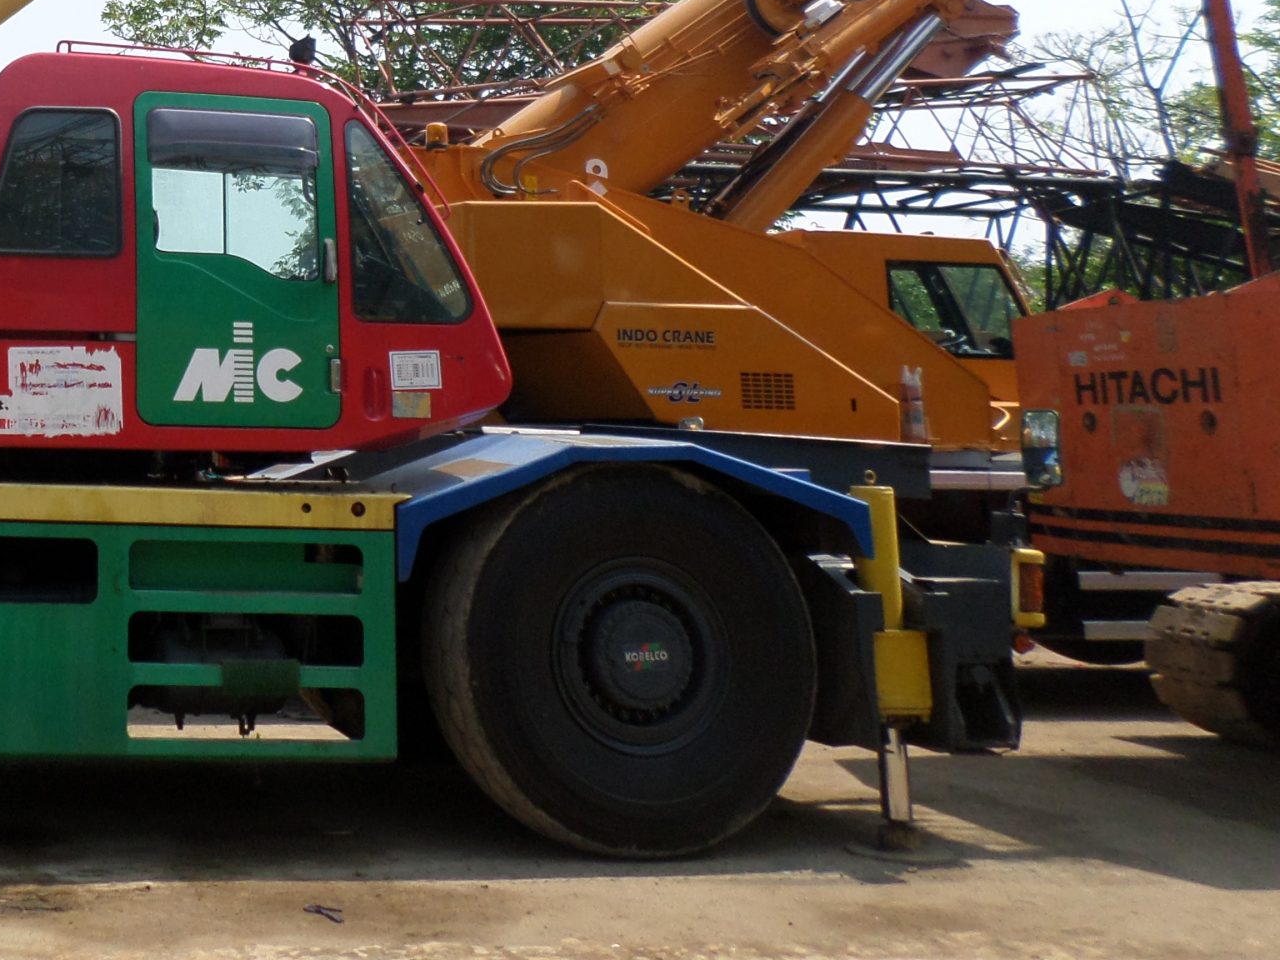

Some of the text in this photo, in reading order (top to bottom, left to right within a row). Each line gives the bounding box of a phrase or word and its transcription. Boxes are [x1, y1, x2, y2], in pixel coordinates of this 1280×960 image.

[617, 328, 715, 344] INDO CRANE
[1074, 367, 1222, 405] HITACHI
[625, 651, 668, 662] KOBELCO
